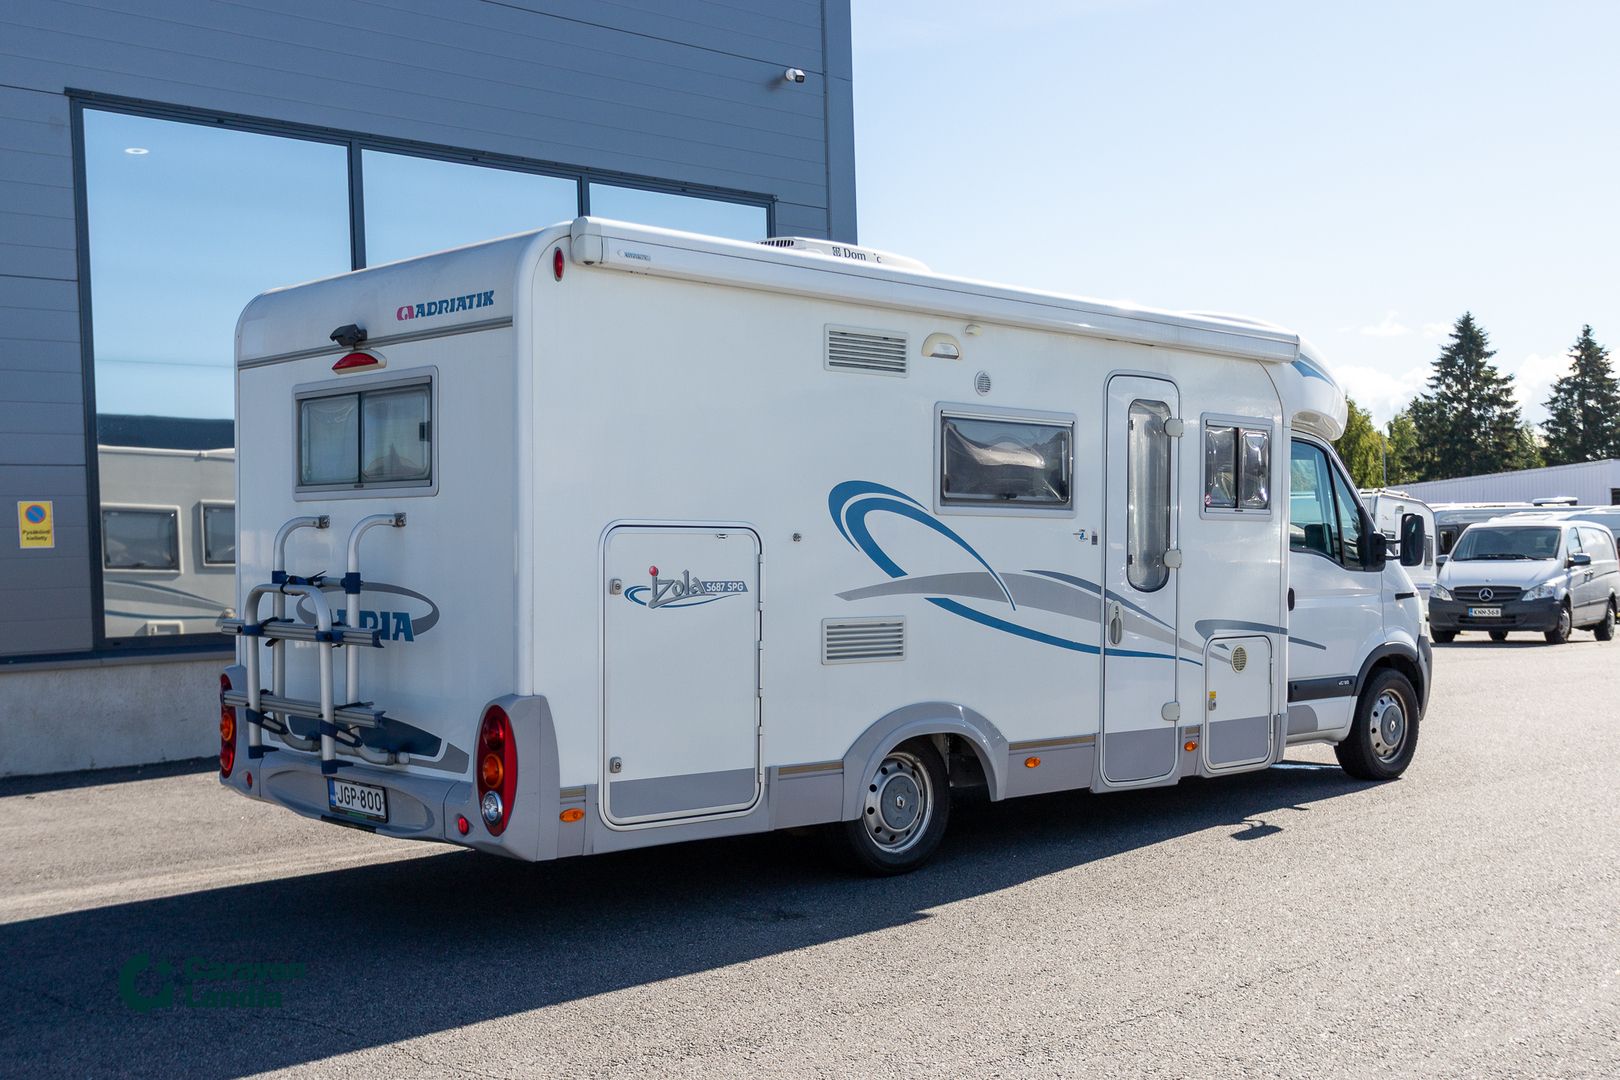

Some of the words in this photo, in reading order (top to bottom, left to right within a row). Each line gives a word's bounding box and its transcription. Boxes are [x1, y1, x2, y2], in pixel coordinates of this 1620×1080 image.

[415, 290, 495, 318] ADRIATIK
[706, 582, 725, 592] S687
[727, 582, 744, 592] SPG
[337, 785, 382, 812] JGP-800
